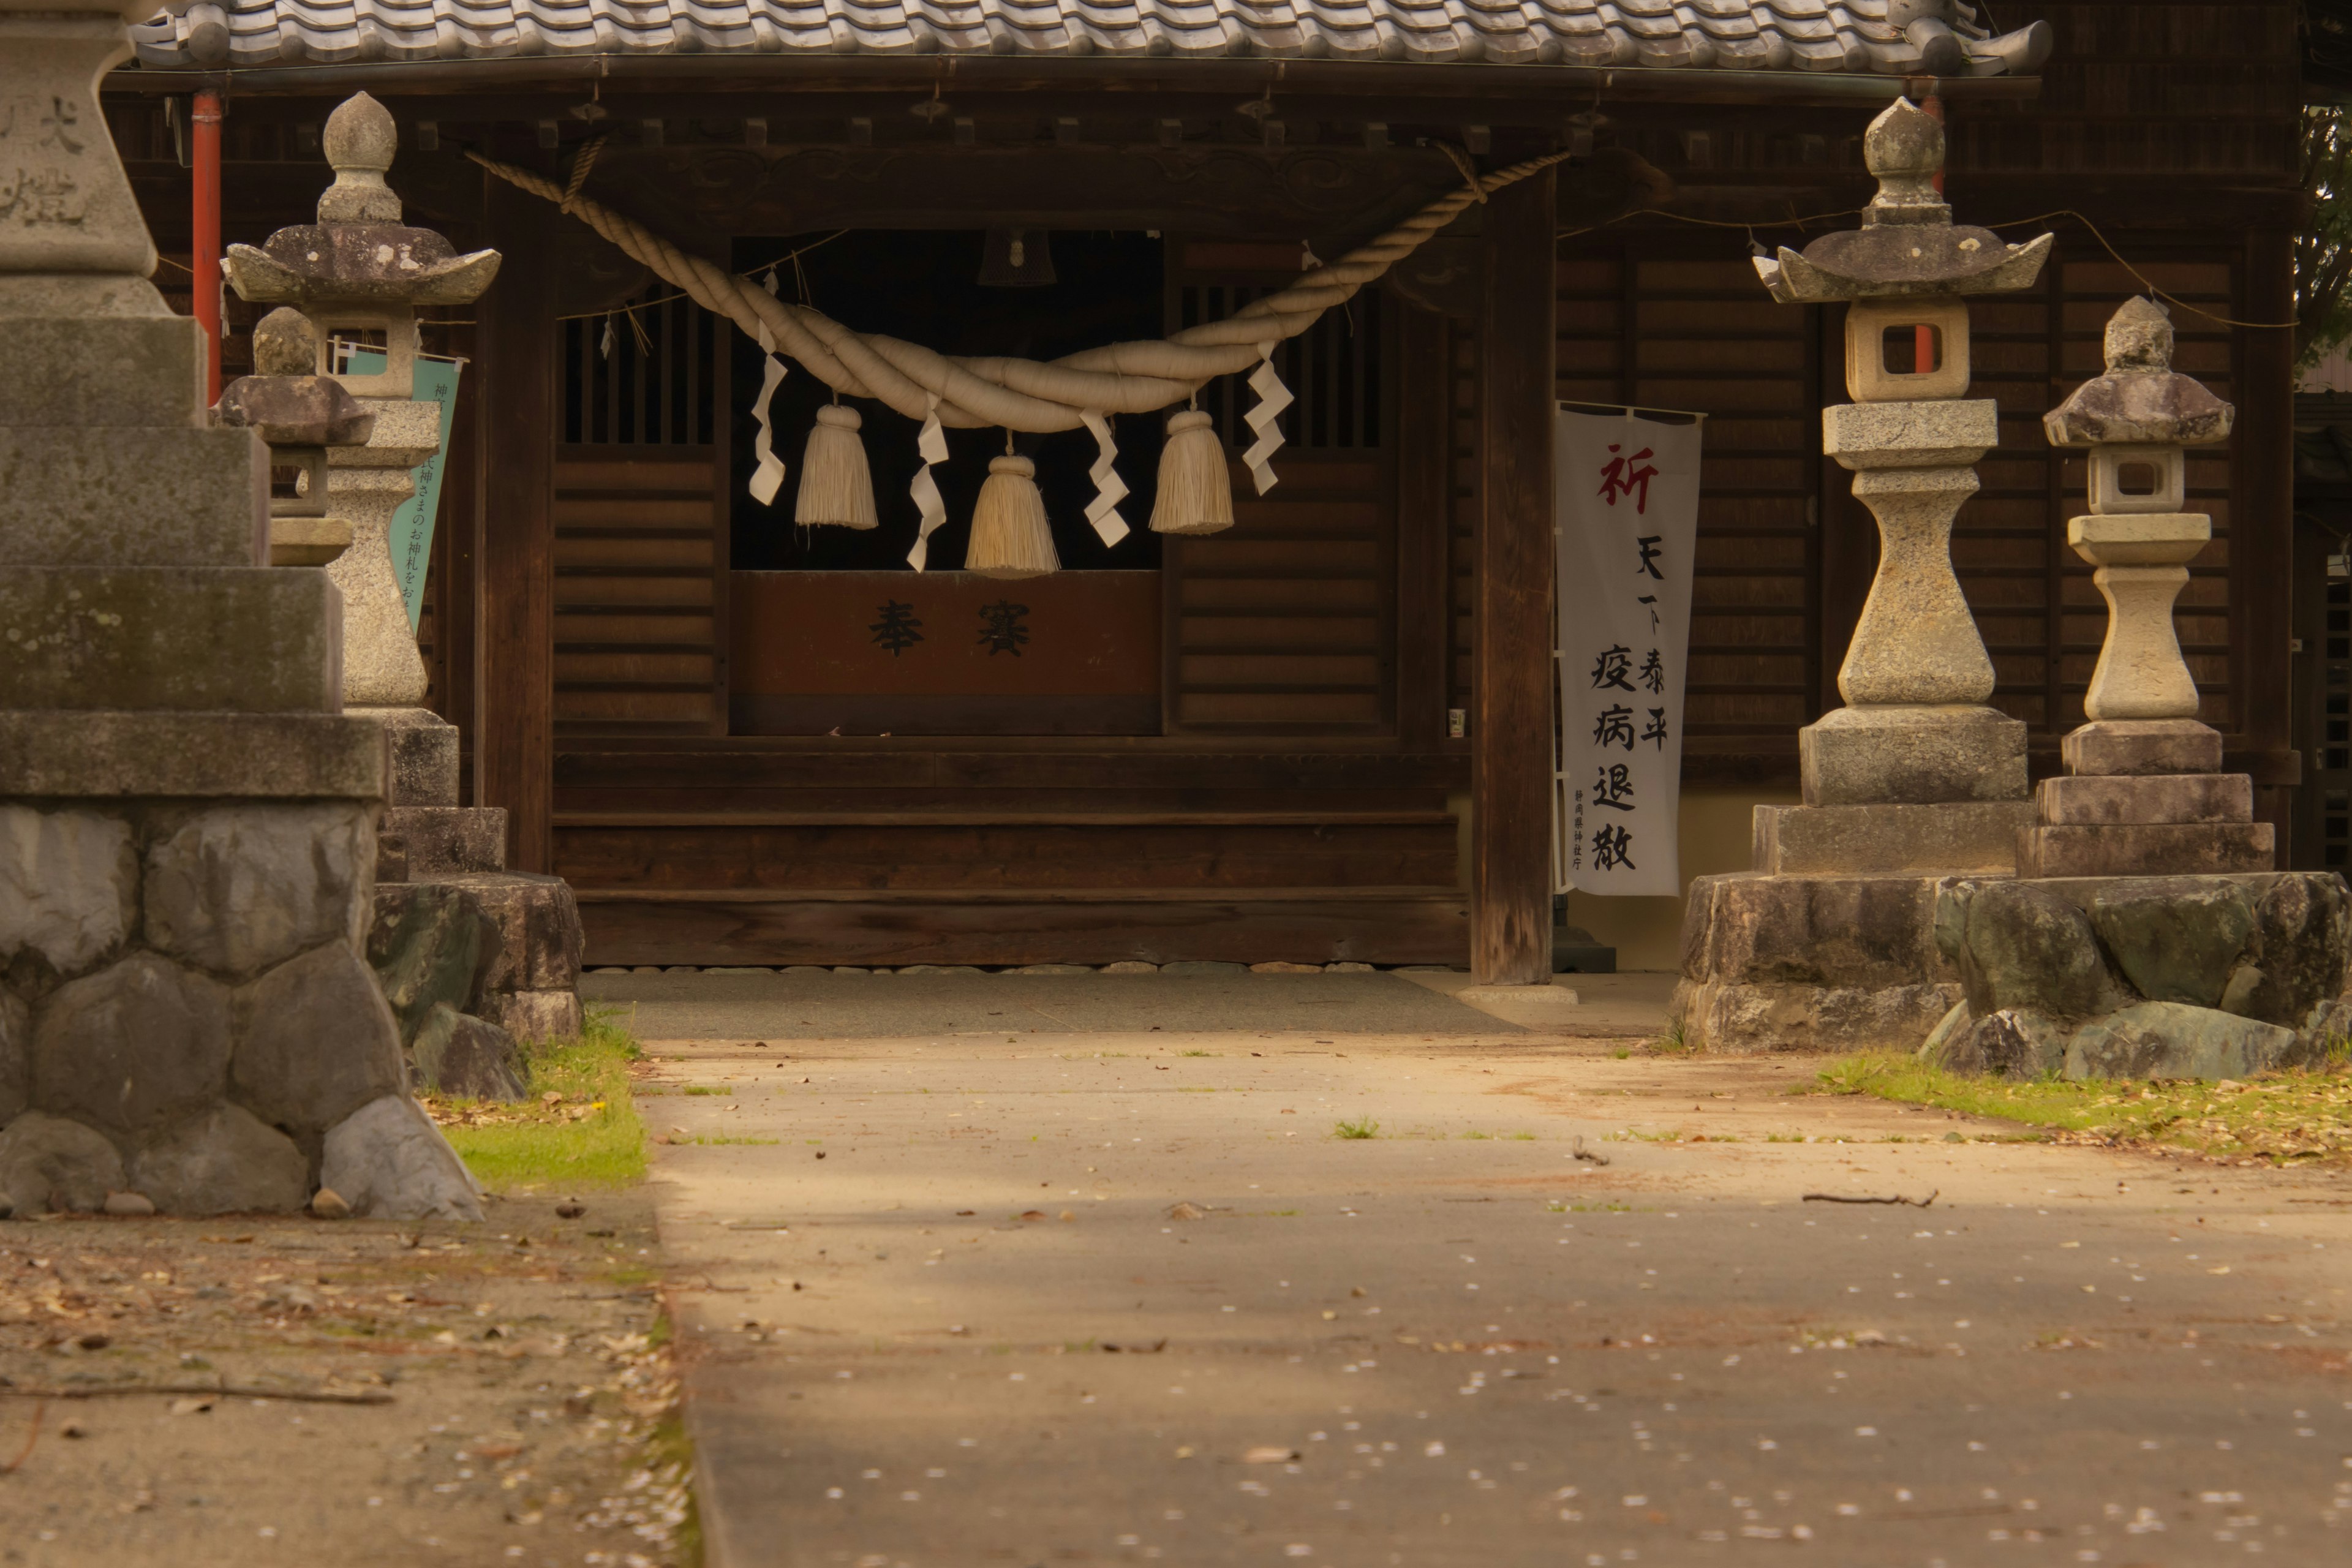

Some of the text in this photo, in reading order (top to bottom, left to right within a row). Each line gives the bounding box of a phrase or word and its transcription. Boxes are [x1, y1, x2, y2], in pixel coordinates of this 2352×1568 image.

[402, 383, 448, 608] 神氏神さまのお神札をお
[1596, 443, 1660, 515] 祈
[1635, 535, 1668, 753] 天下泰平
[1572, 790, 1584, 871] 静岡県神社庁
[1590, 644, 1637, 872] 疫病退散
